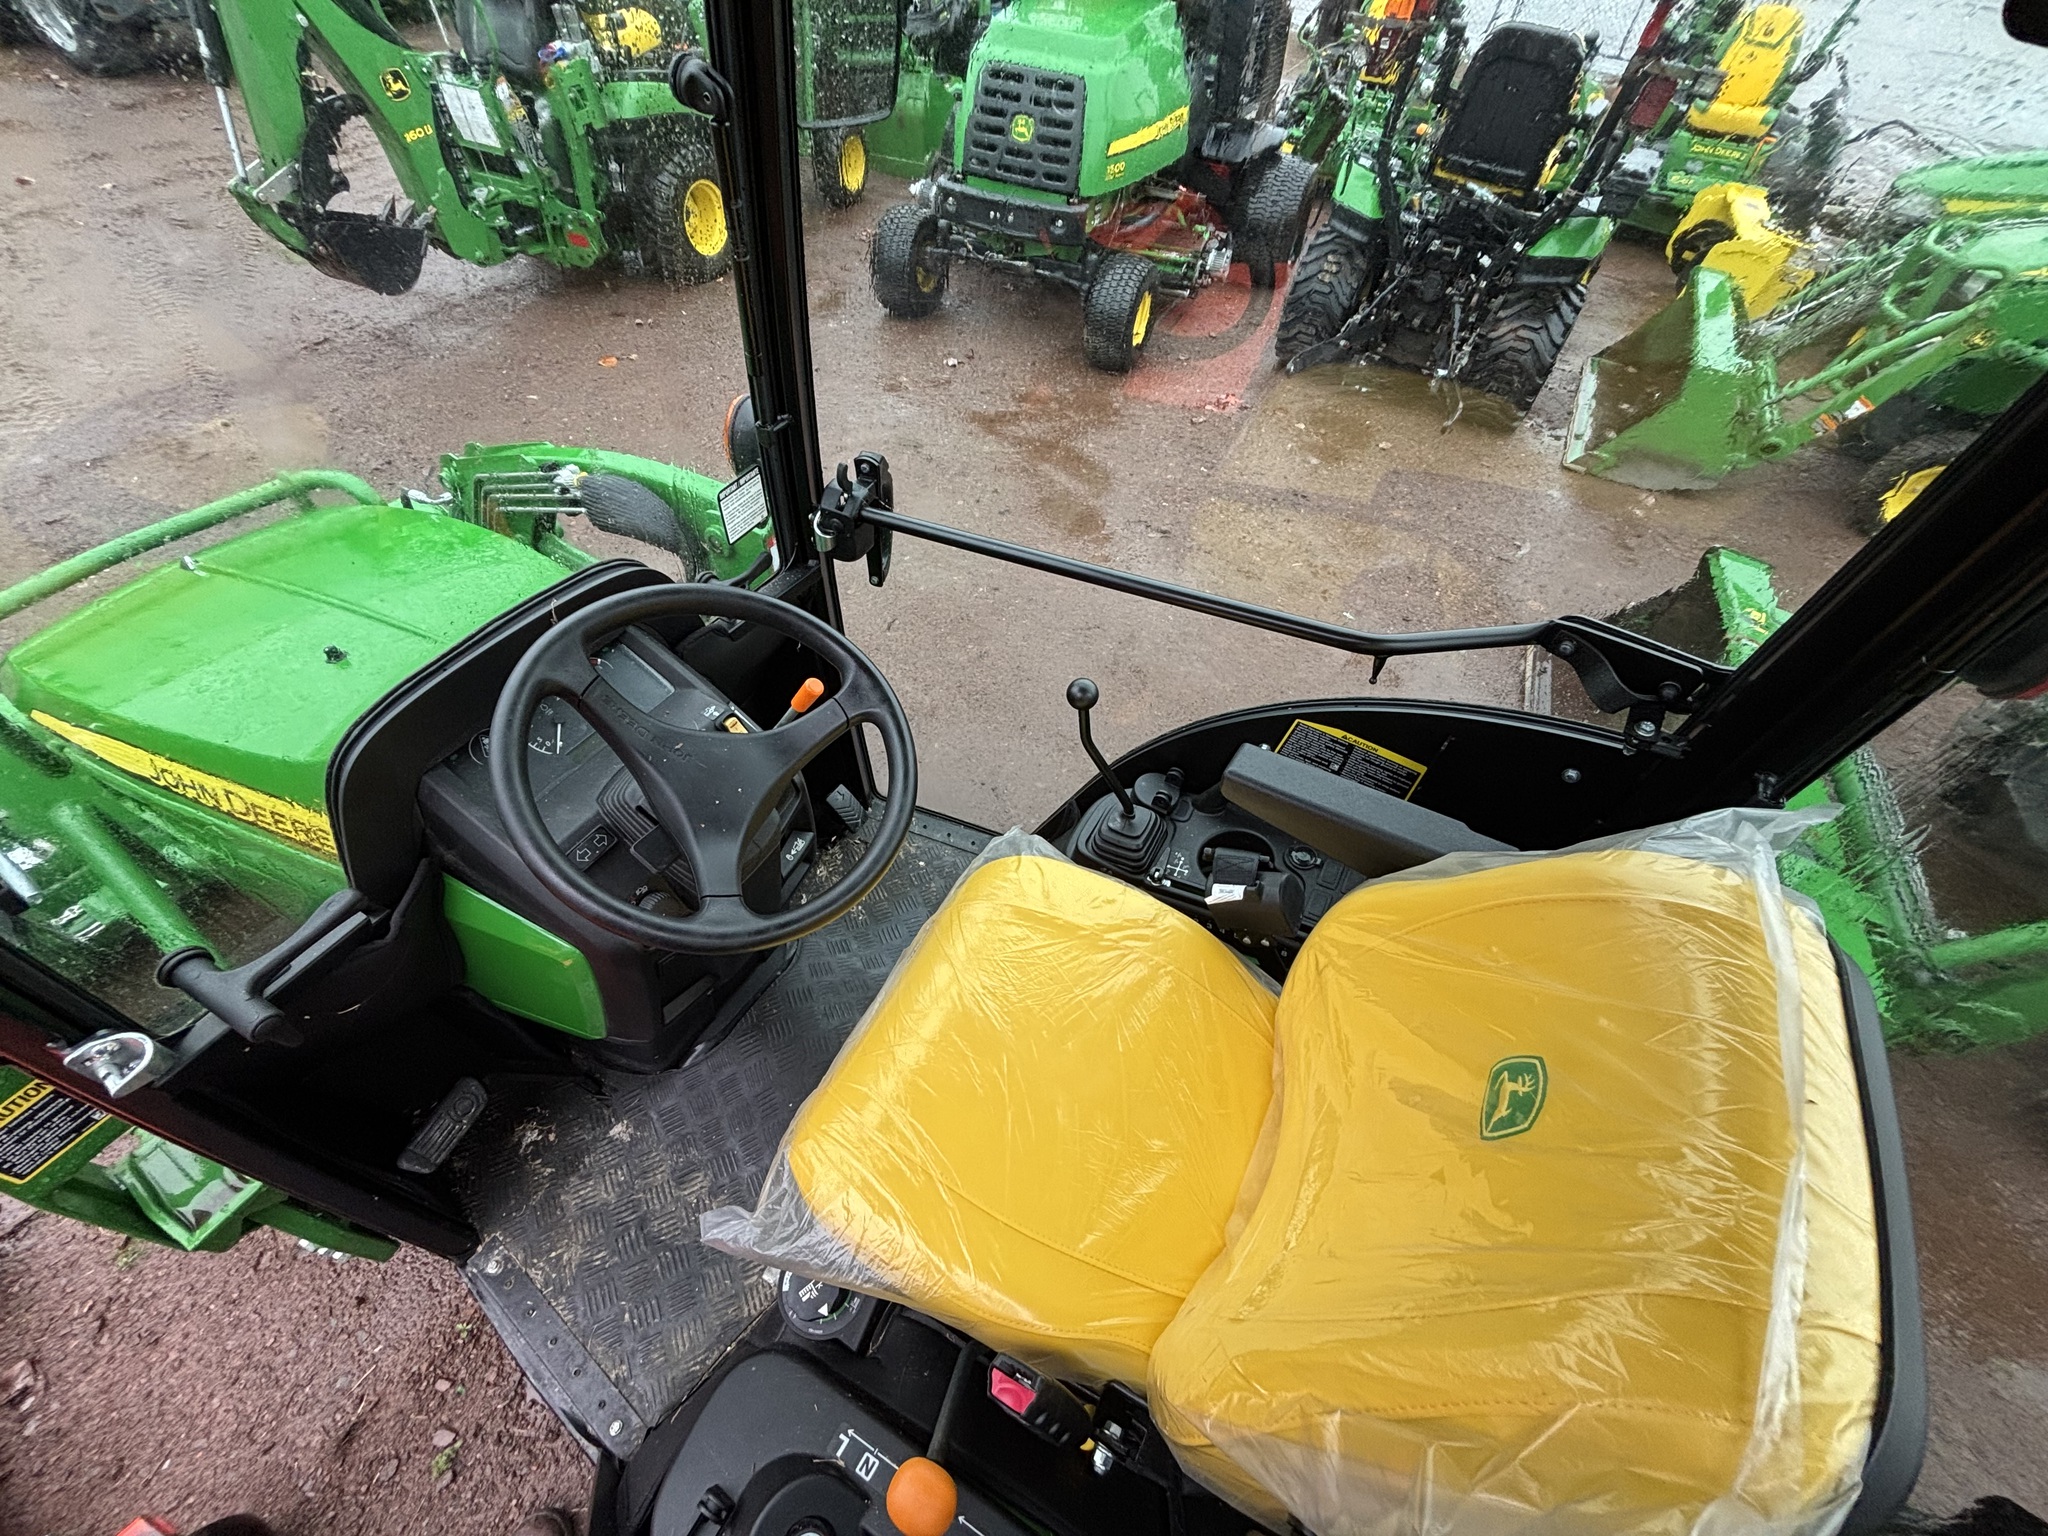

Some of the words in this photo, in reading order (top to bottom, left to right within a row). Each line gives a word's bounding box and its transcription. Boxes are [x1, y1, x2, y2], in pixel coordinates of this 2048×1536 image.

[1347, 736, 1379, 753] CAUTION
[150, 757, 223, 808] JOHN
[224, 787, 337, 855] DEERE
[0, 1082, 49, 1121] UTION
